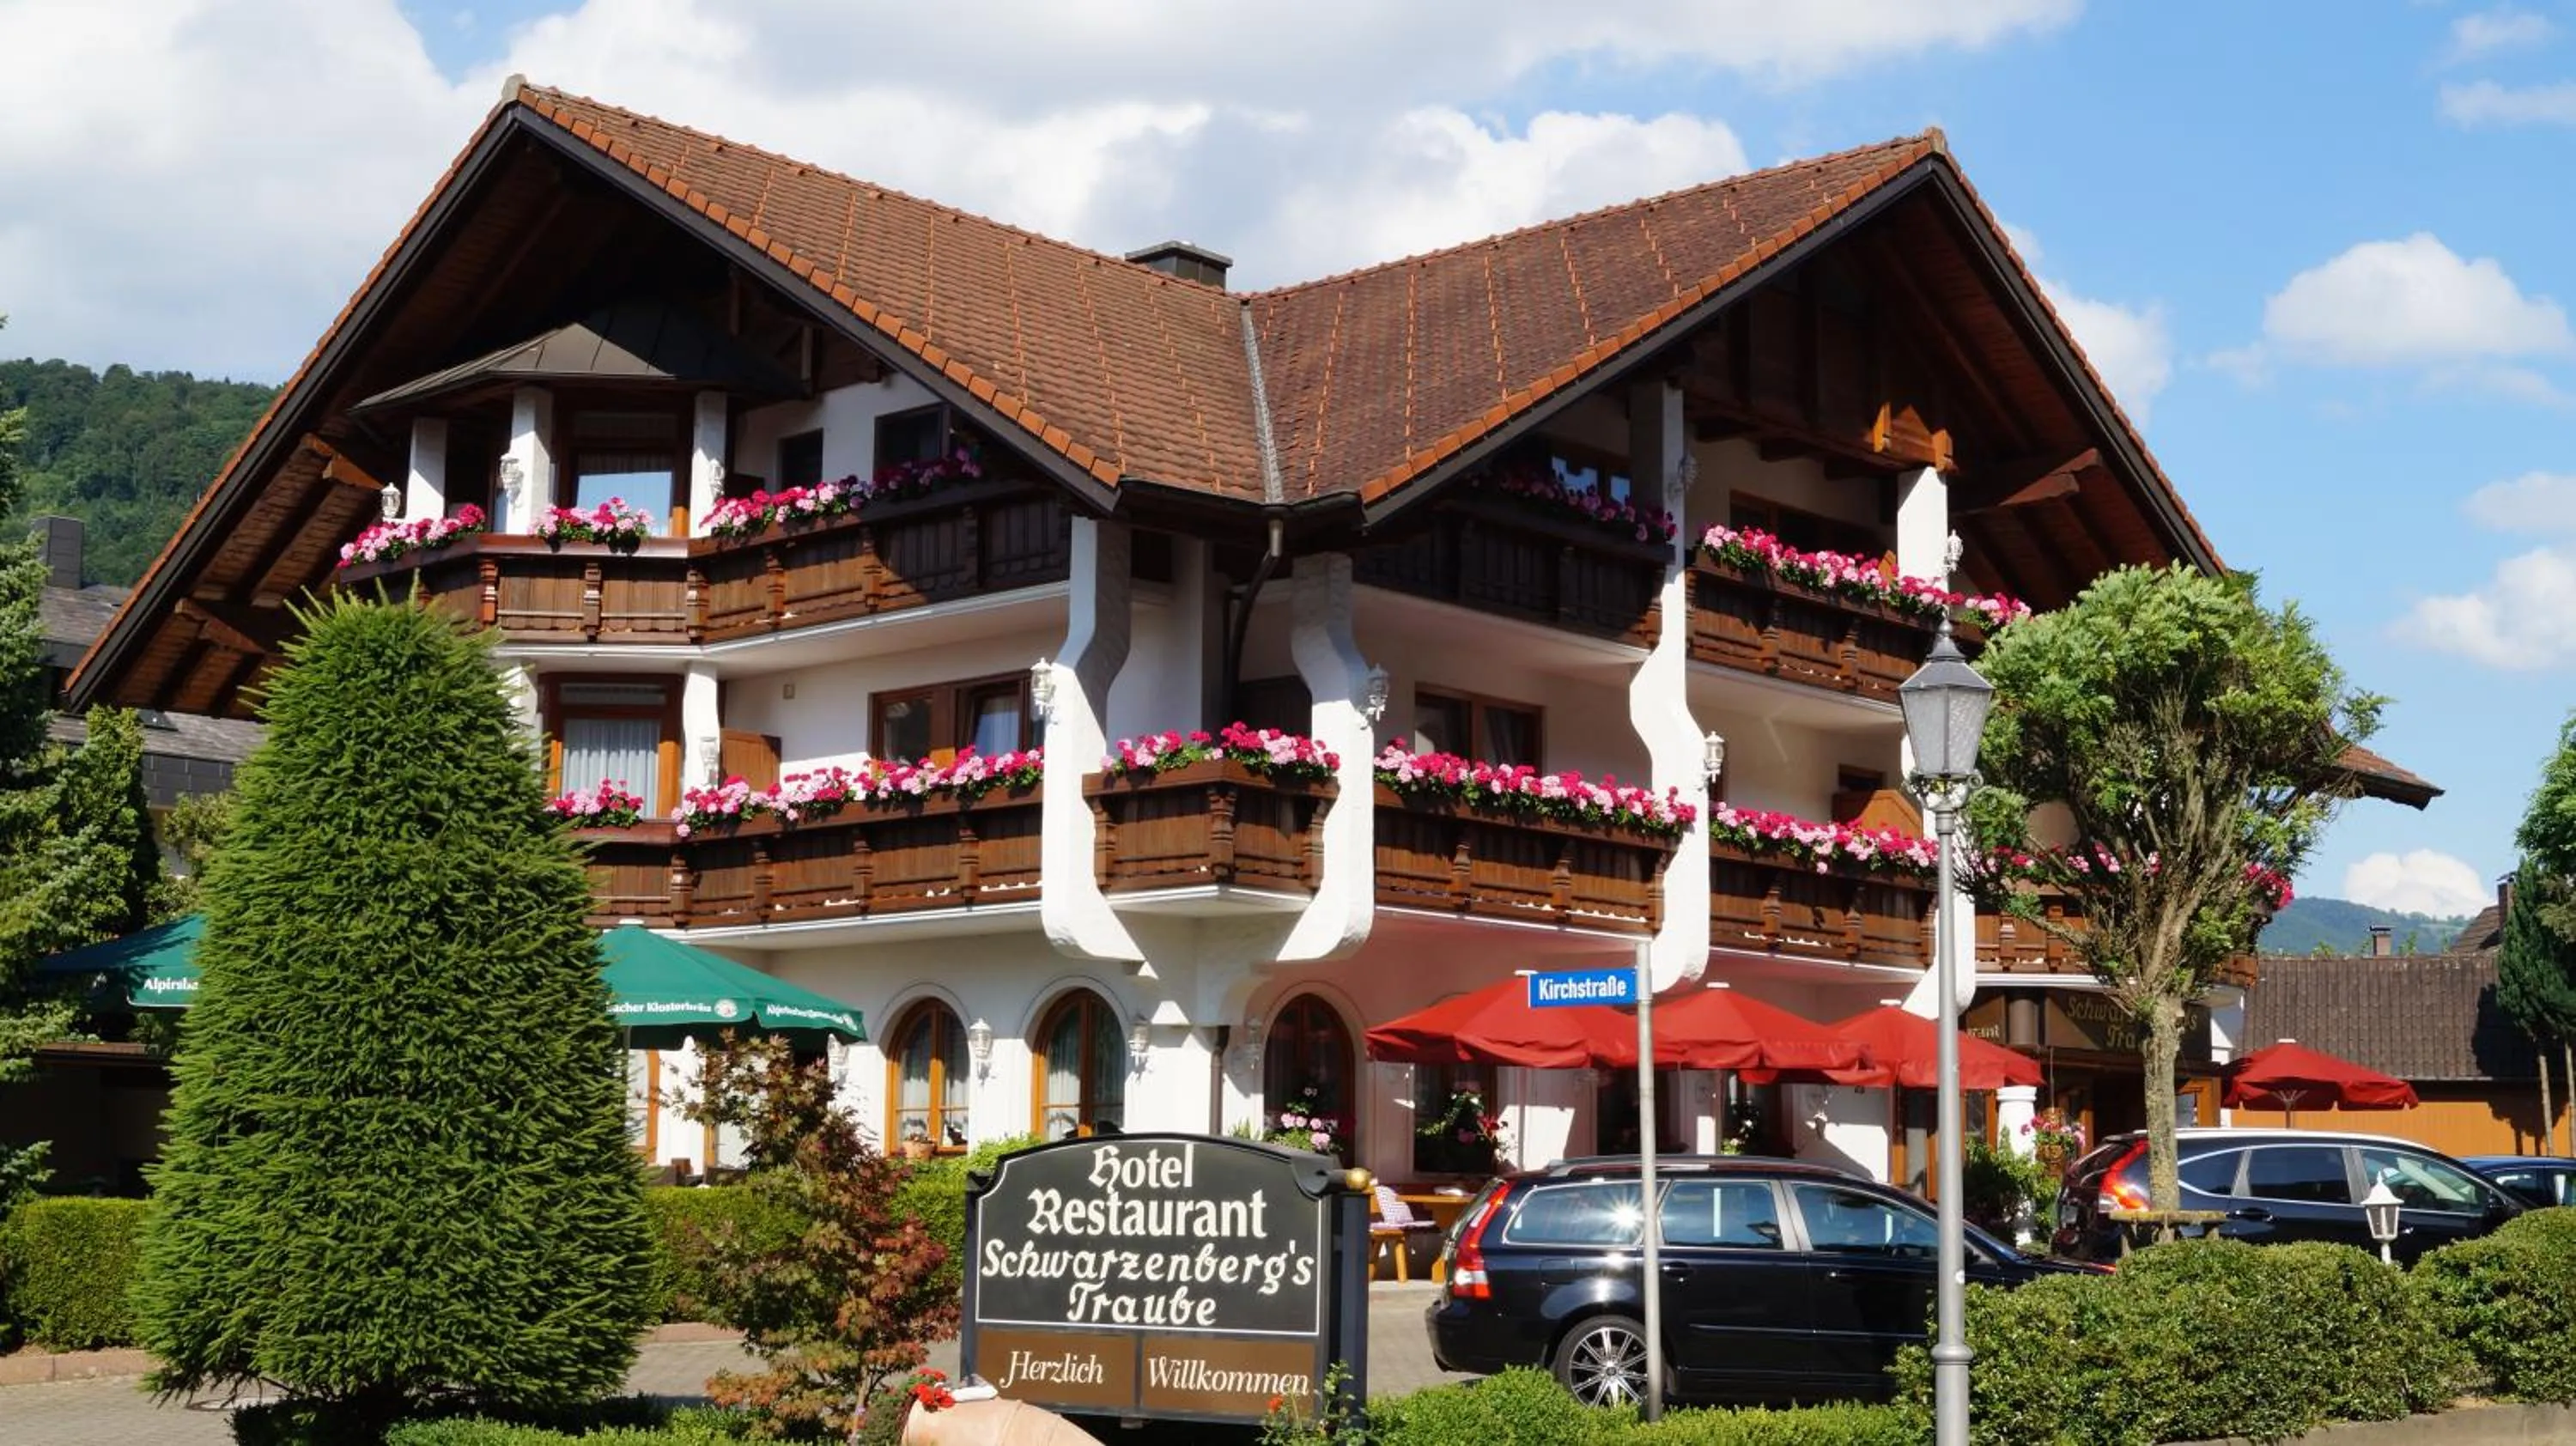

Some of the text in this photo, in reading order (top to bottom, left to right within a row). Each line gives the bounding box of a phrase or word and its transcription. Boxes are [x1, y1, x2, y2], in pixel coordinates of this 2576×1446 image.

[1539, 975, 1627, 1001] Kirchstraße
[1088, 1144, 1194, 1193] Hotel
[1027, 1188, 1267, 1238] Restaurant
[981, 1238, 1315, 1295] Schwarzenberg's
[1066, 1279, 1217, 1327] Traube
[999, 1351, 1309, 1396] Herzlich Willkommen
